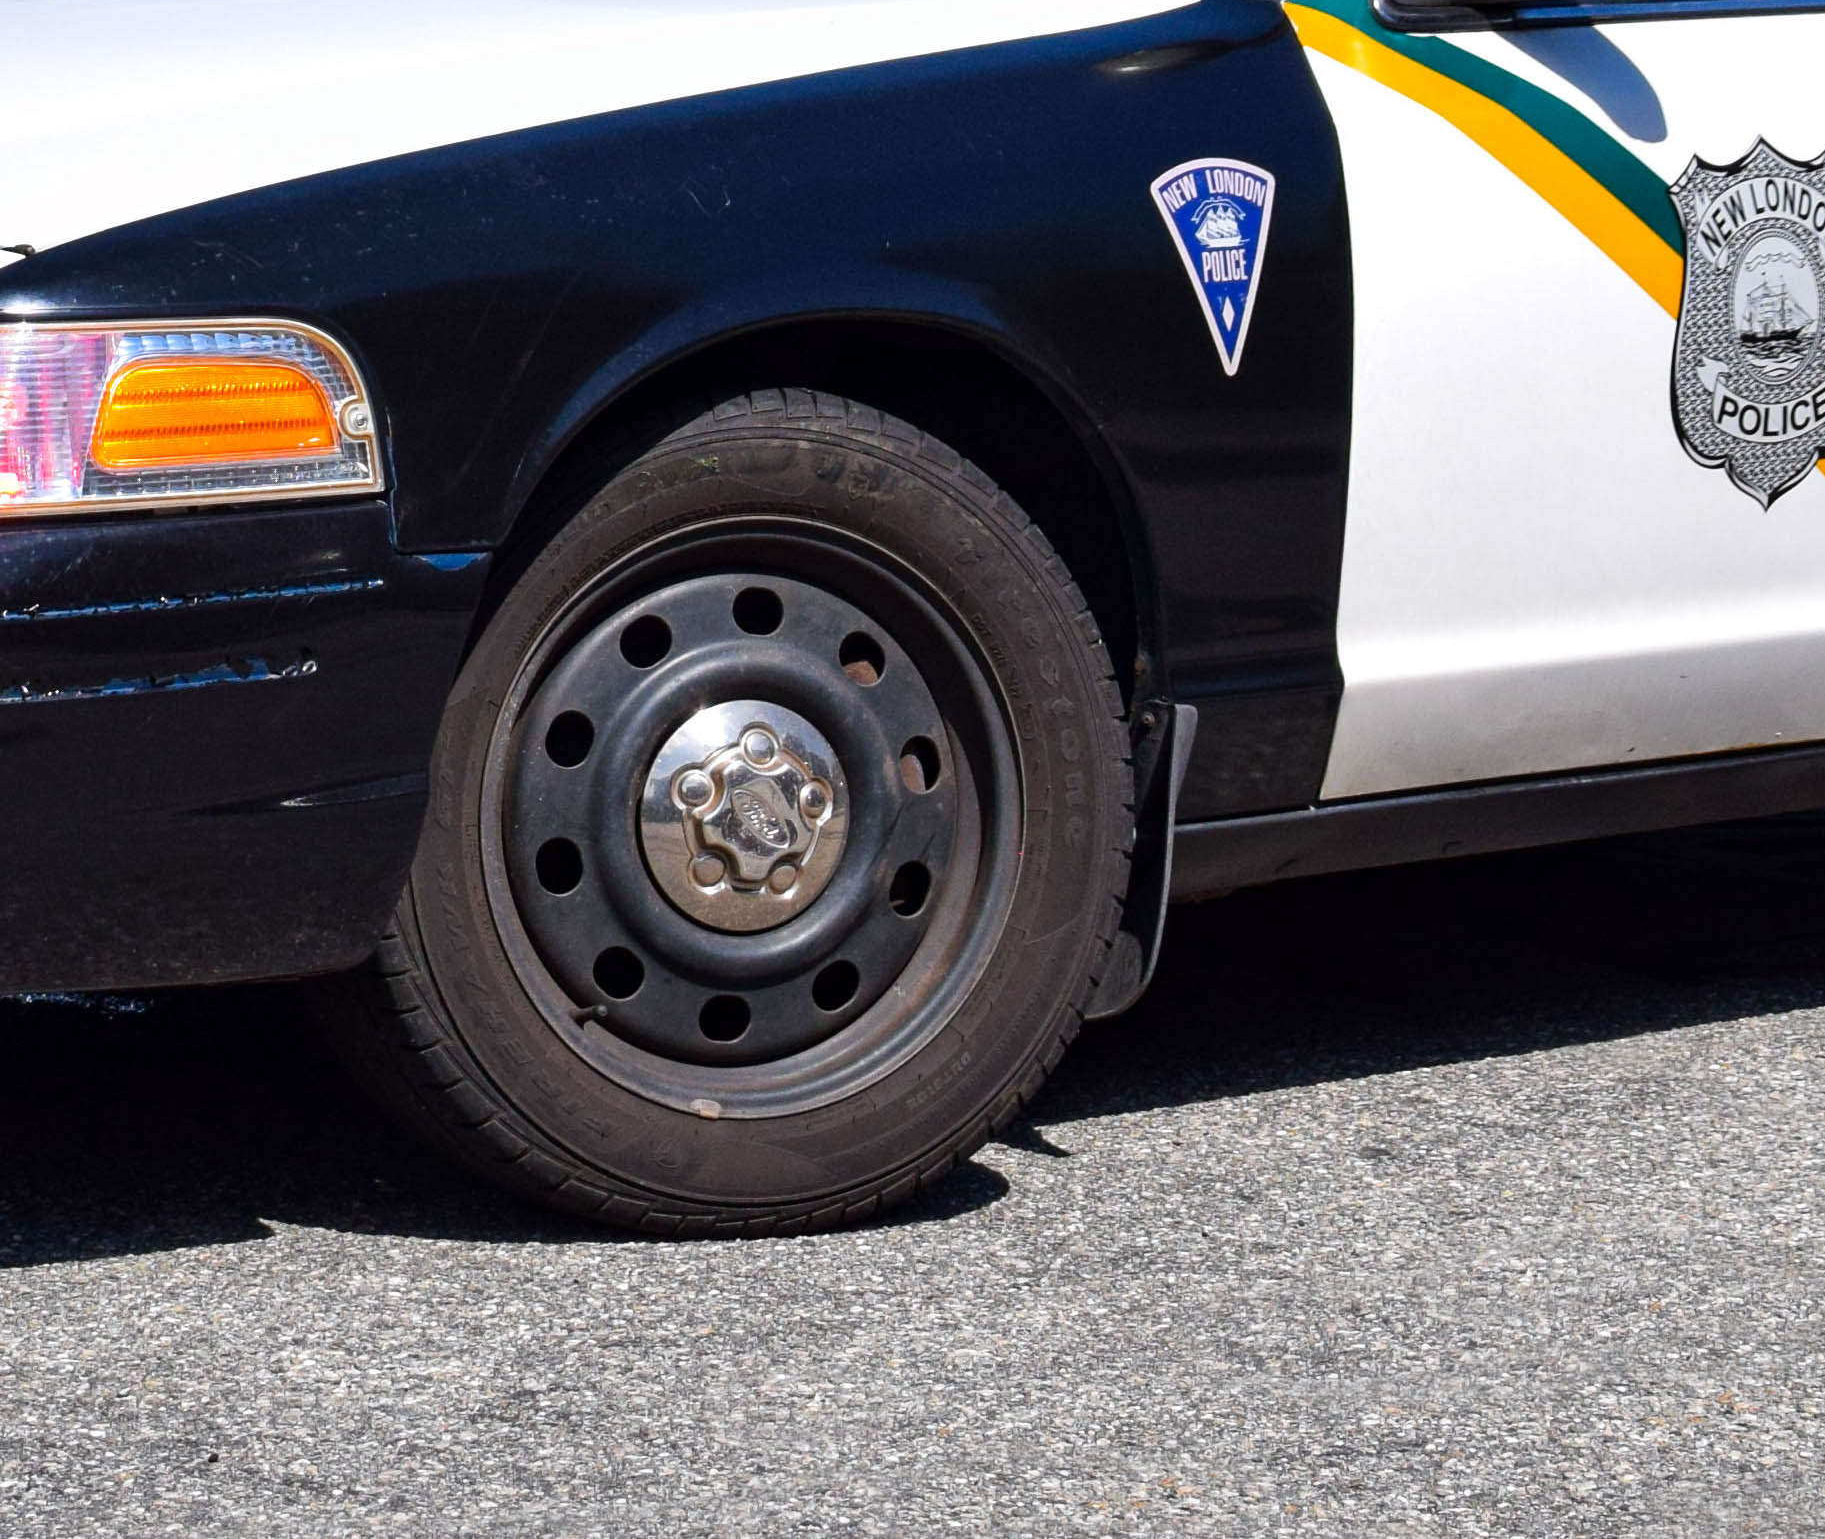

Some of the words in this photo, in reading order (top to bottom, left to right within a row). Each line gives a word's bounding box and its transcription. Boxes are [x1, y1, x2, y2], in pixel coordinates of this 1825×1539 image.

[1162, 174, 1198, 213] NEW
[1206, 169, 1267, 207] LONDON
[1699, 192, 1747, 253] NEW
[1202, 249, 1248, 283] POLICE
